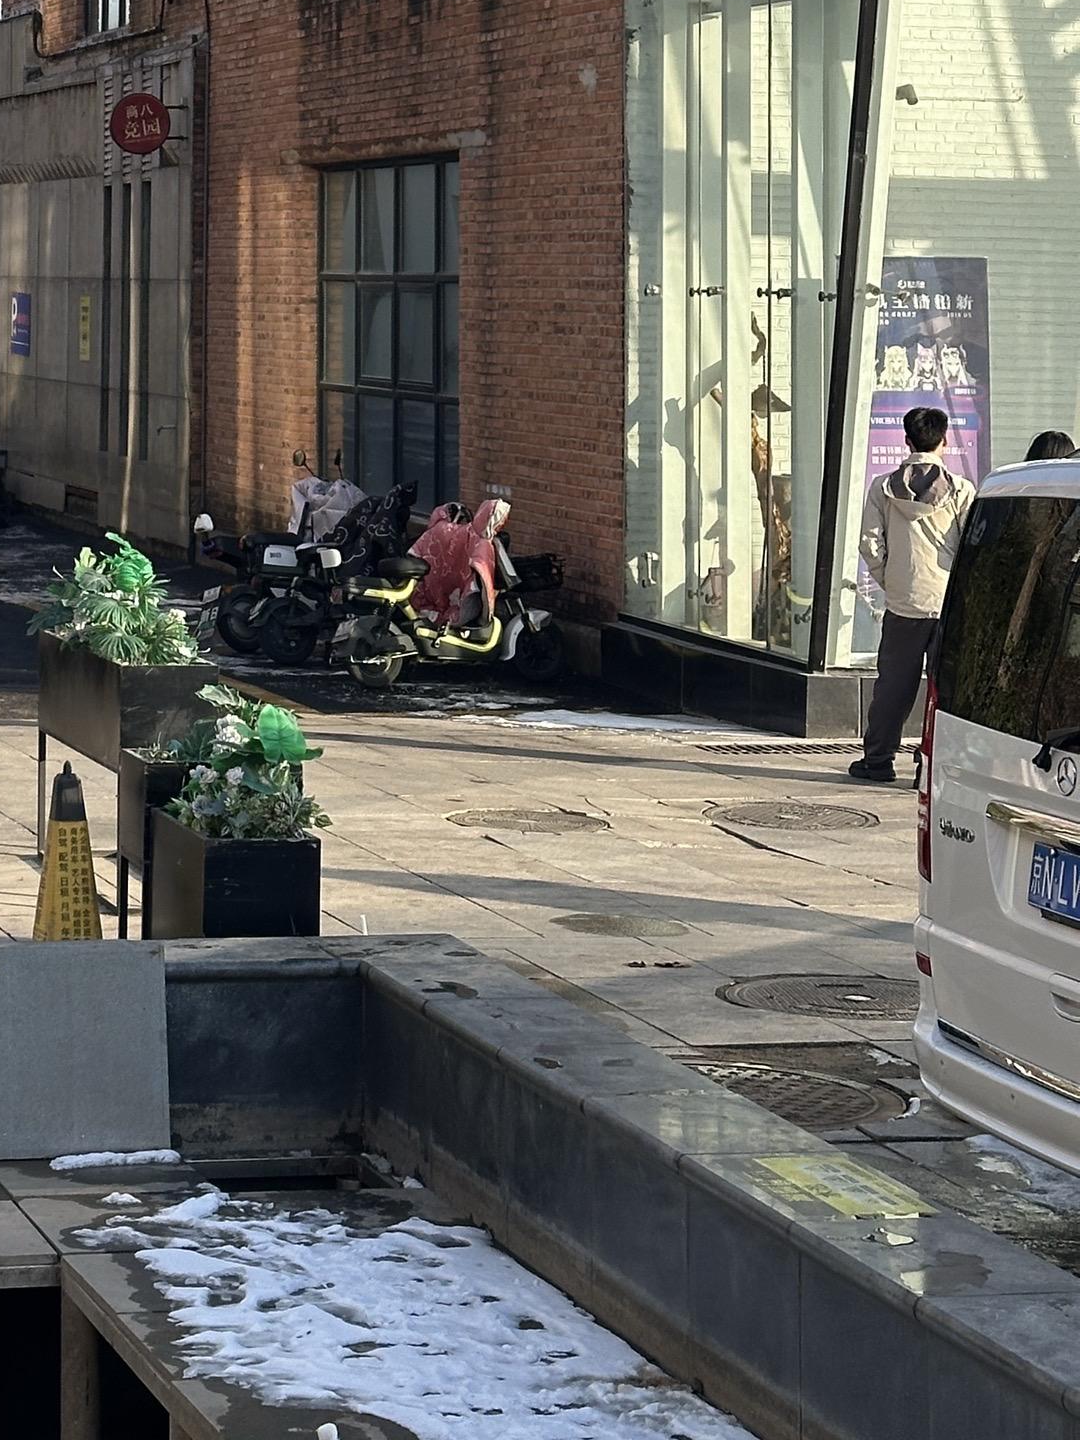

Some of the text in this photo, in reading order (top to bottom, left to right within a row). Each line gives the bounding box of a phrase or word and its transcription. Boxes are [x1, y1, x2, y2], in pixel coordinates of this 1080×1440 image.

[61, 927, 70, 941] 年
[73, 909, 82, 941] 剧组用
